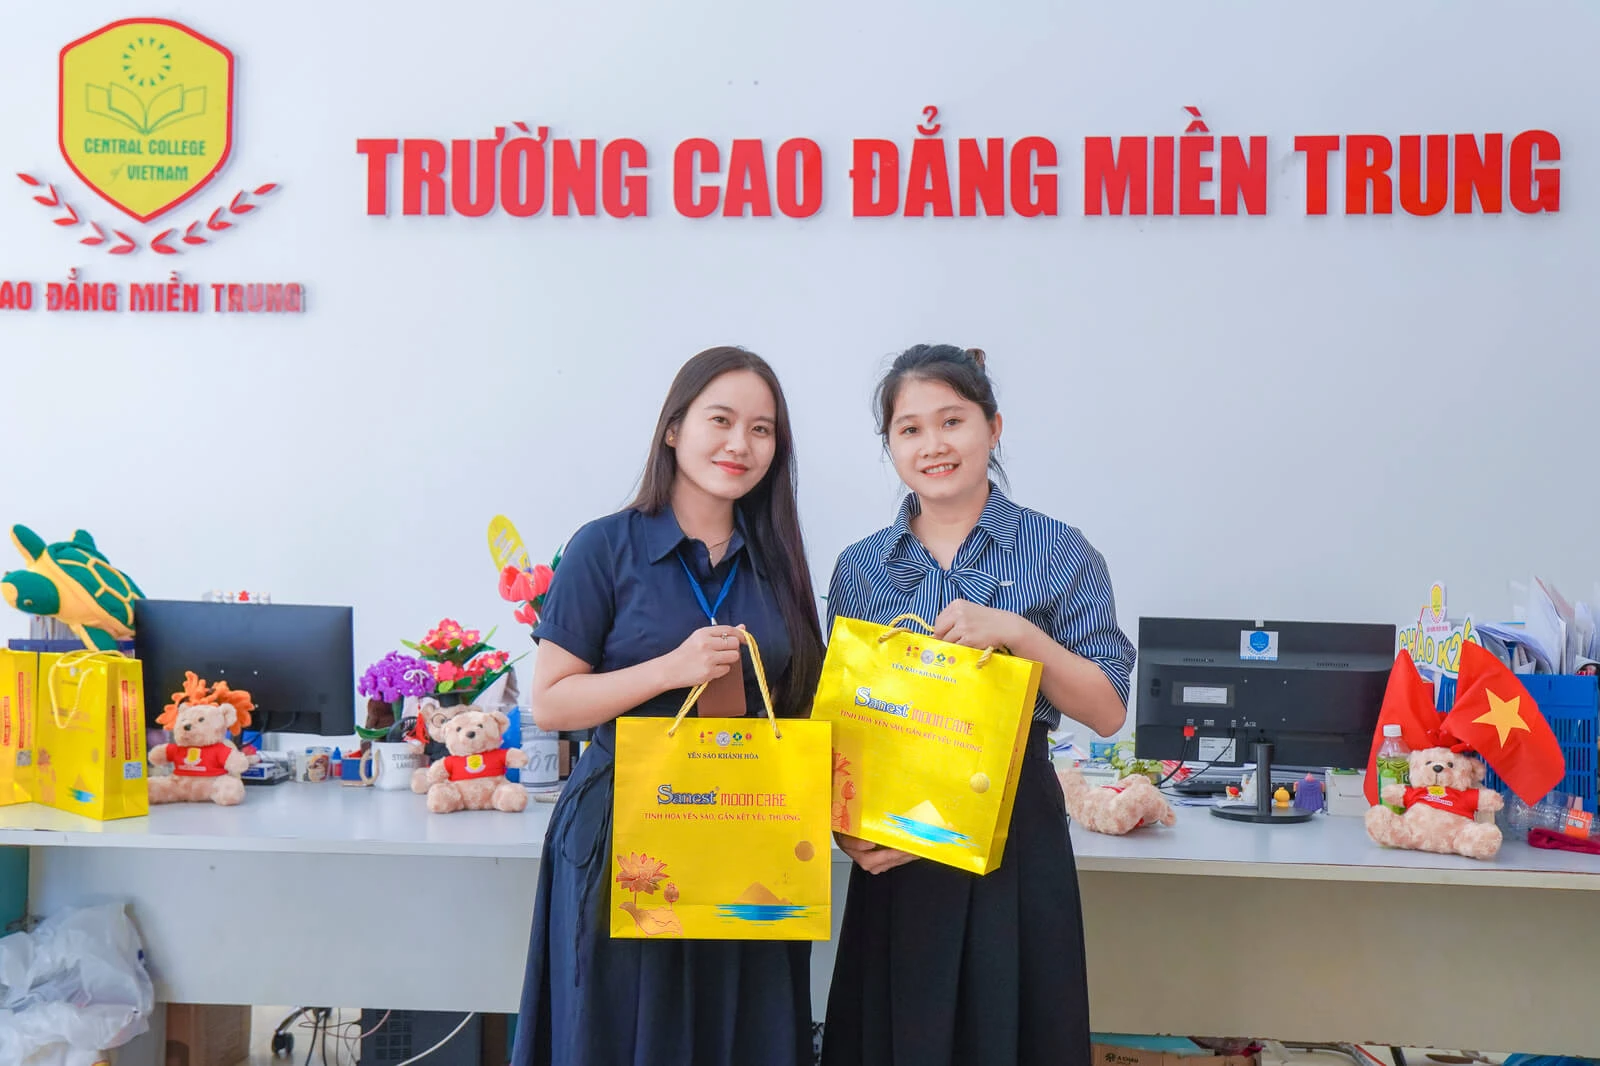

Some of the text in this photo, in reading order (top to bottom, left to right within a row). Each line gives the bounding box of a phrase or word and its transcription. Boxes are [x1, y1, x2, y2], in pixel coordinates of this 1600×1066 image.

[84, 138, 206, 156] CENTRAL COLLEGE
[127, 165, 189, 181] VIETNAM
[356, 105, 1561, 218] TRƯỜNG CAO ĐẲNG MIỀN TRUNG
[129, 270, 199, 312] MIỀN
[211, 282, 301, 312] TRUNG
[855, 687, 909, 718] Sanest
[657, 784, 787, 807] Sanest MOON CAKE
